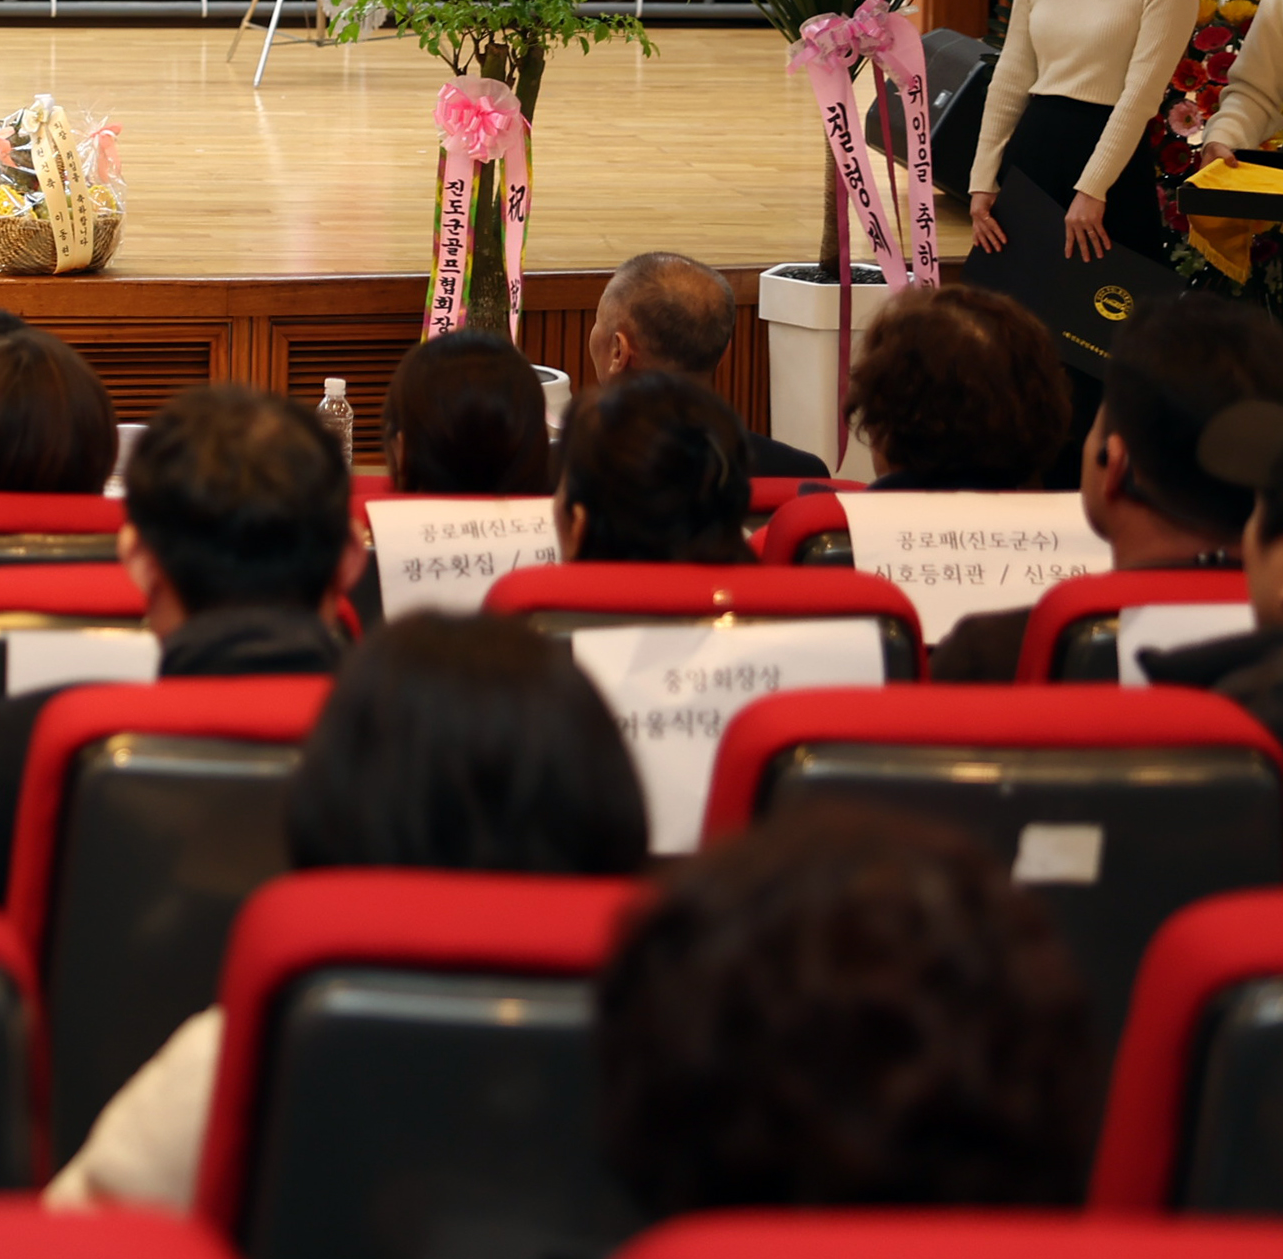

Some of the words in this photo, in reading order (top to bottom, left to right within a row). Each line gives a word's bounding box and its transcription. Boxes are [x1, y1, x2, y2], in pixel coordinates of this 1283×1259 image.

[508, 184, 526, 222] 祝
[432, 179, 465, 334] 진도군골프협회장
[896, 531, 1059, 552] 공로패(진도군수)
